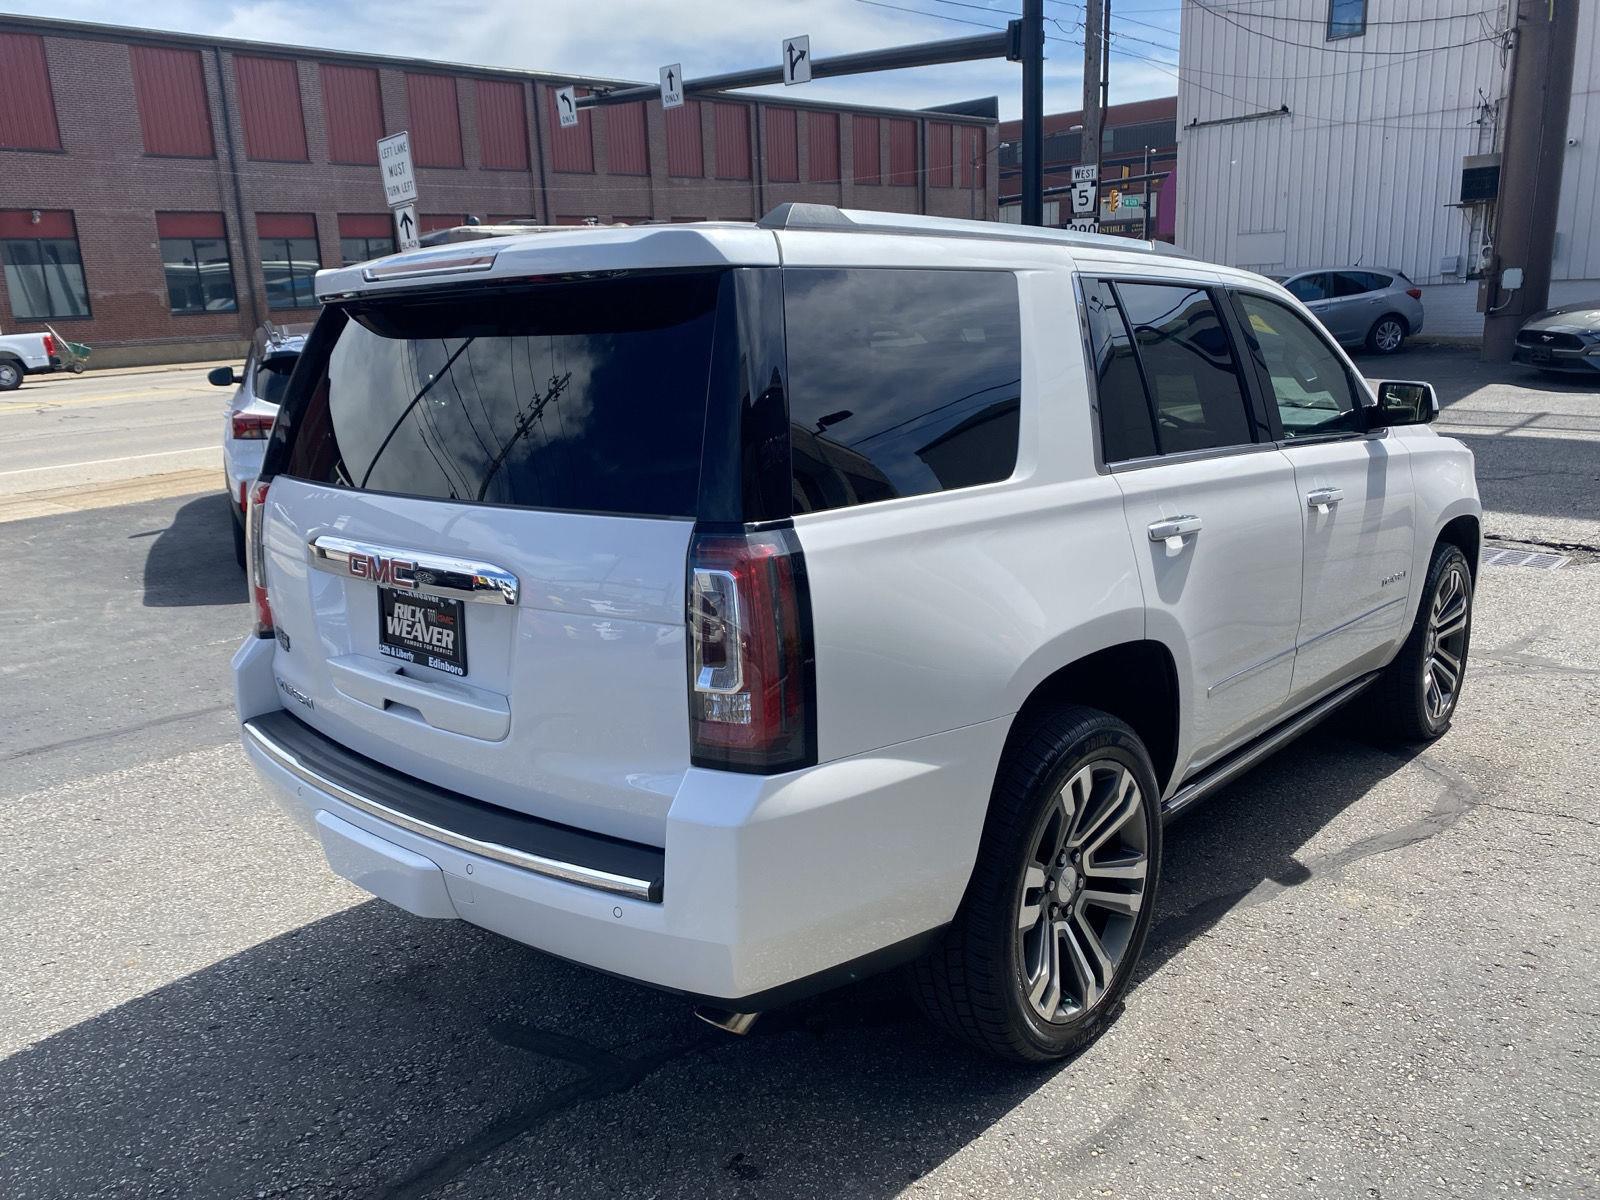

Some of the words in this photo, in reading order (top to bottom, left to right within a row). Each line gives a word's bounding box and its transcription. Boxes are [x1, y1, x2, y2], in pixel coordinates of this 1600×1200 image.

[664, 92, 680, 104] ONLY
[562, 114, 575, 124] ONLY
[381, 146, 393, 159] LEFT
[394, 141, 407, 155] LANE
[388, 161, 405, 177] MUST
[1074, 168, 1095, 179] WEST
[387, 184, 400, 197] TURN
[401, 180, 414, 193] LEFT
[1078, 189, 1089, 206] 5
[349, 552, 417, 590] GMC
[393, 602, 425, 622] RICK
[386, 615, 454, 649] WEAVER
[391, 646, 396, 656] &
[396, 648, 414, 662] Liberty
[404, 639, 422, 648] FAMOUS
[423, 642, 433, 650] FOR
[433, 645, 453, 656] SERVICE
[428, 656, 463, 676] Edinboro
